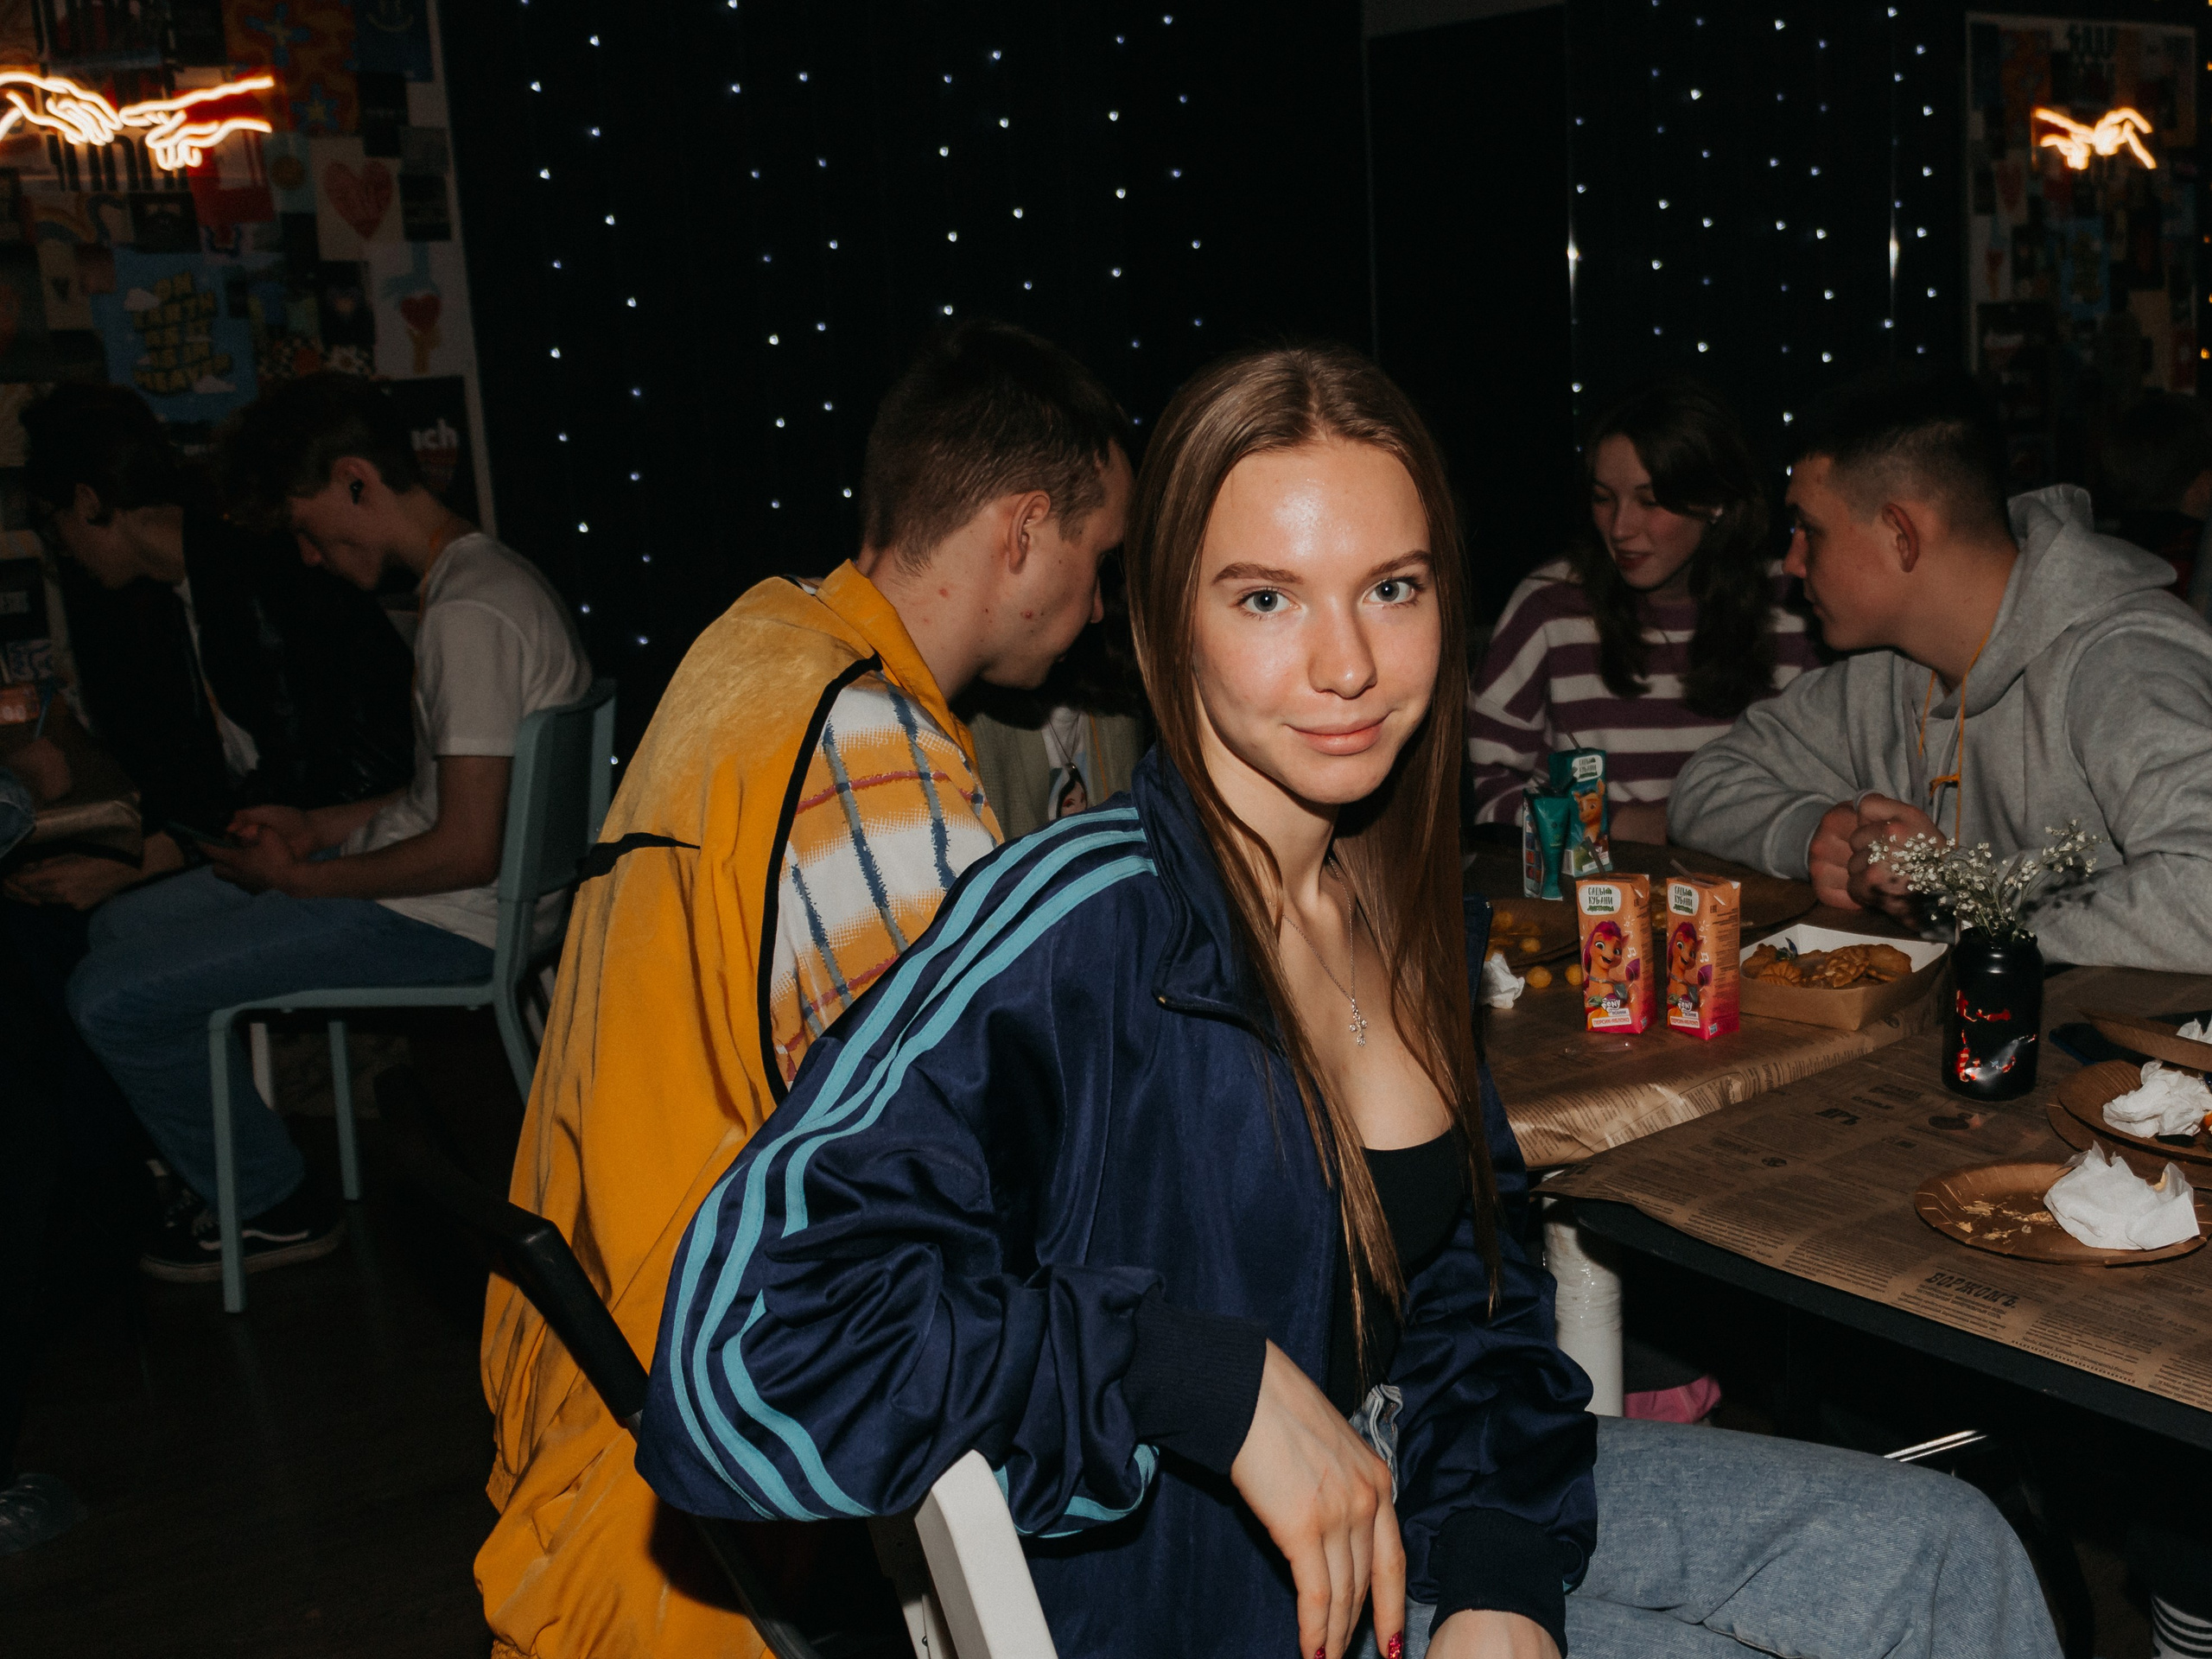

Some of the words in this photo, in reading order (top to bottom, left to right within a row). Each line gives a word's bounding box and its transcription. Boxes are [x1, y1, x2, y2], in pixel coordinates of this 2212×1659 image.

[1588, 887, 1605, 896] САДЫ
[1588, 896, 1613, 905] КУБАНИ
[1601, 1000, 1621, 1010] PONY
